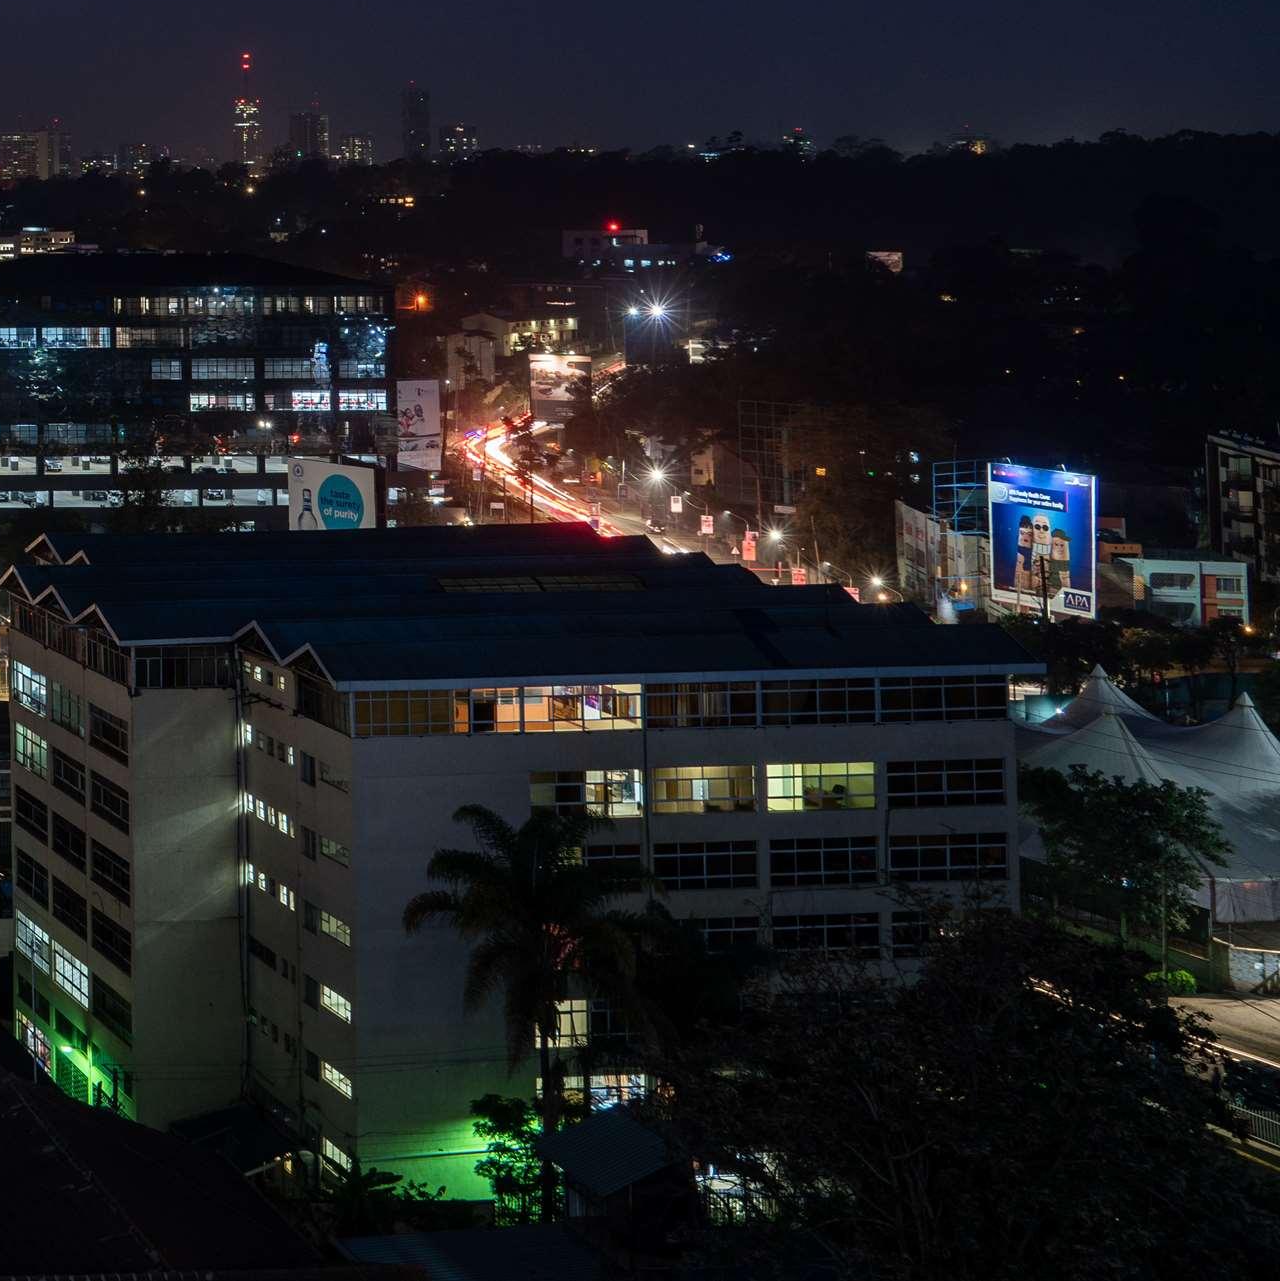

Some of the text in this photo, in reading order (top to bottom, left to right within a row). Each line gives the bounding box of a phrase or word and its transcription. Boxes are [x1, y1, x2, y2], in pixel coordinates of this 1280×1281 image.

[323, 507, 359, 522] of purity
[1066, 593, 1089, 607] APA
